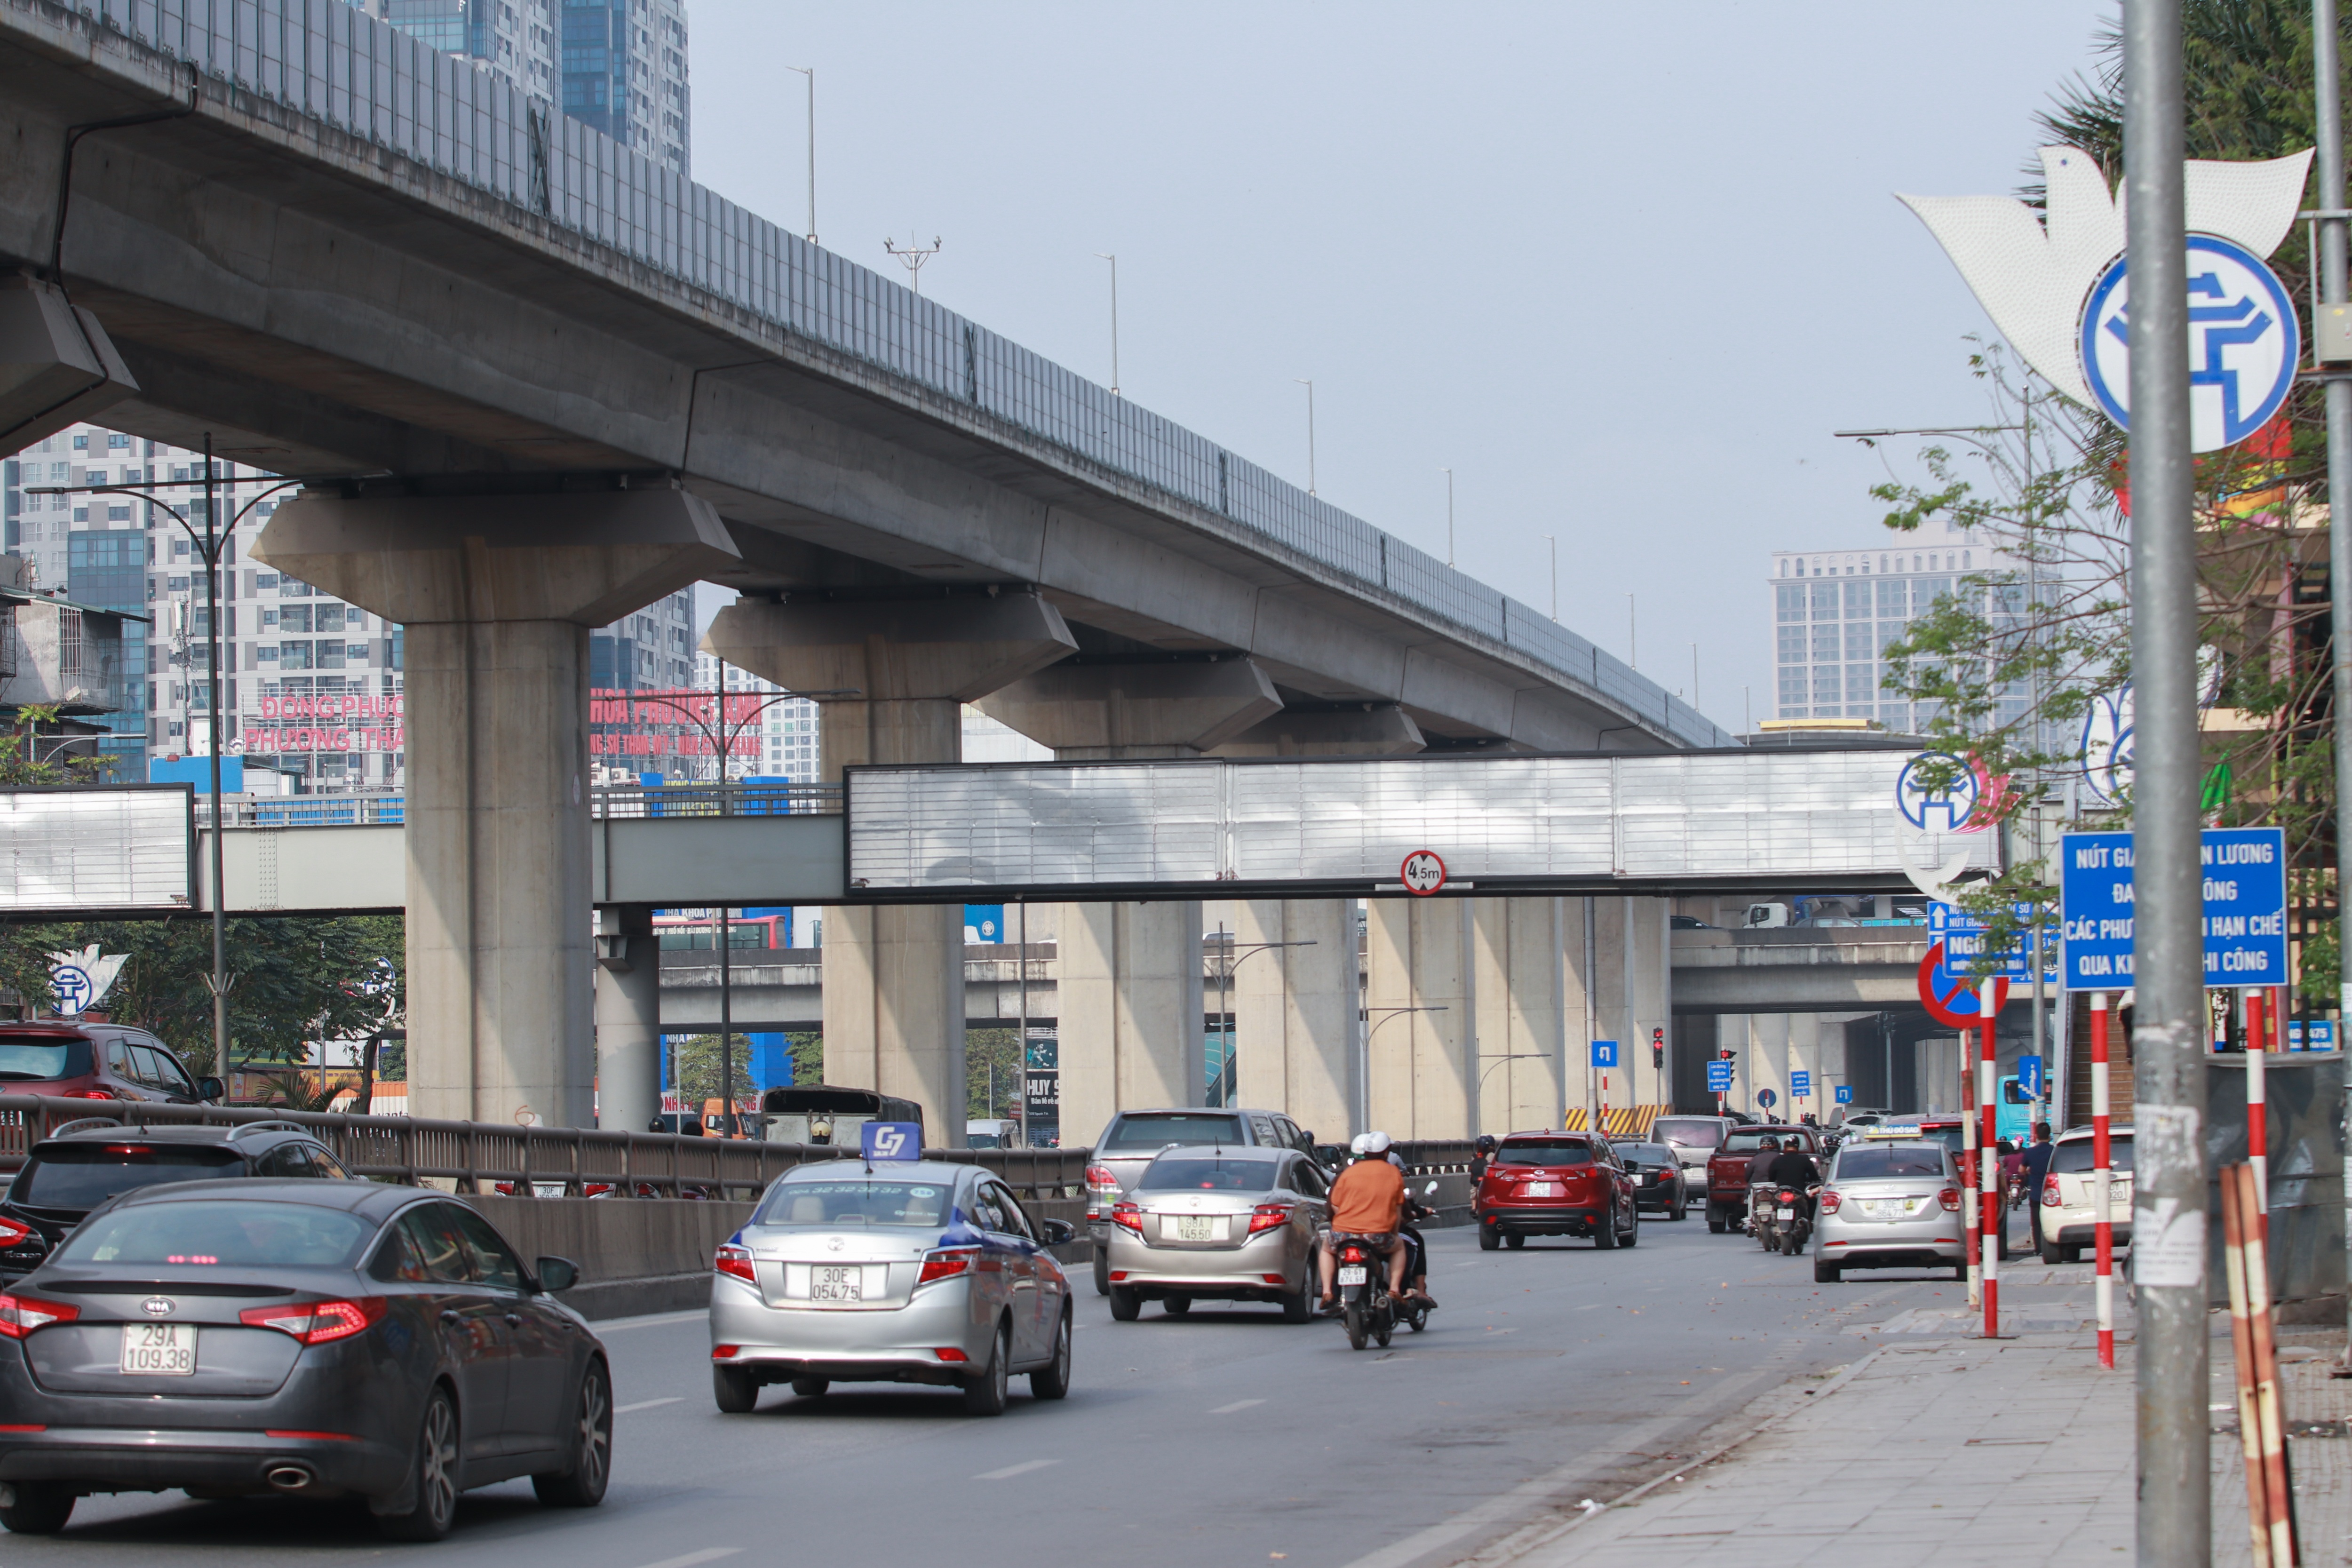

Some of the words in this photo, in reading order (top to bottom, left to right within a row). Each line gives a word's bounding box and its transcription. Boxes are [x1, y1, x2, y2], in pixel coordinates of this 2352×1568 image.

[262, 687, 335, 719] ĐỒNG
[724, 691, 762, 725] ANH
[245, 727, 350, 751] PHƯƠNG
[2075, 843, 2110, 869] NÚT
[2217, 843, 2274, 865] LƯƠNG
[682, 907, 706, 918] KHOA
[2064, 915, 2096, 941] CÁC
[2211, 915, 2246, 940] HẠN
[2249, 907, 2283, 936] CHẾ
[2079, 955, 2112, 977] QUA
[2223, 946, 2269, 972] CÔNG
[874, 1126, 906, 1156] G7
[811, 1186, 833, 1194] 32
[834, 1185, 856, 1194] 32
[858, 1185, 879, 1194] 32
[1186, 1217, 1204, 1228] 98A
[1180, 1229, 1211, 1240] 145.50
[824, 1268, 850, 1283] 30E
[813, 1285, 858, 1300] 054.75
[143, 1324, 177, 1347] 29A
[129, 1348, 191, 1369] 109.38
